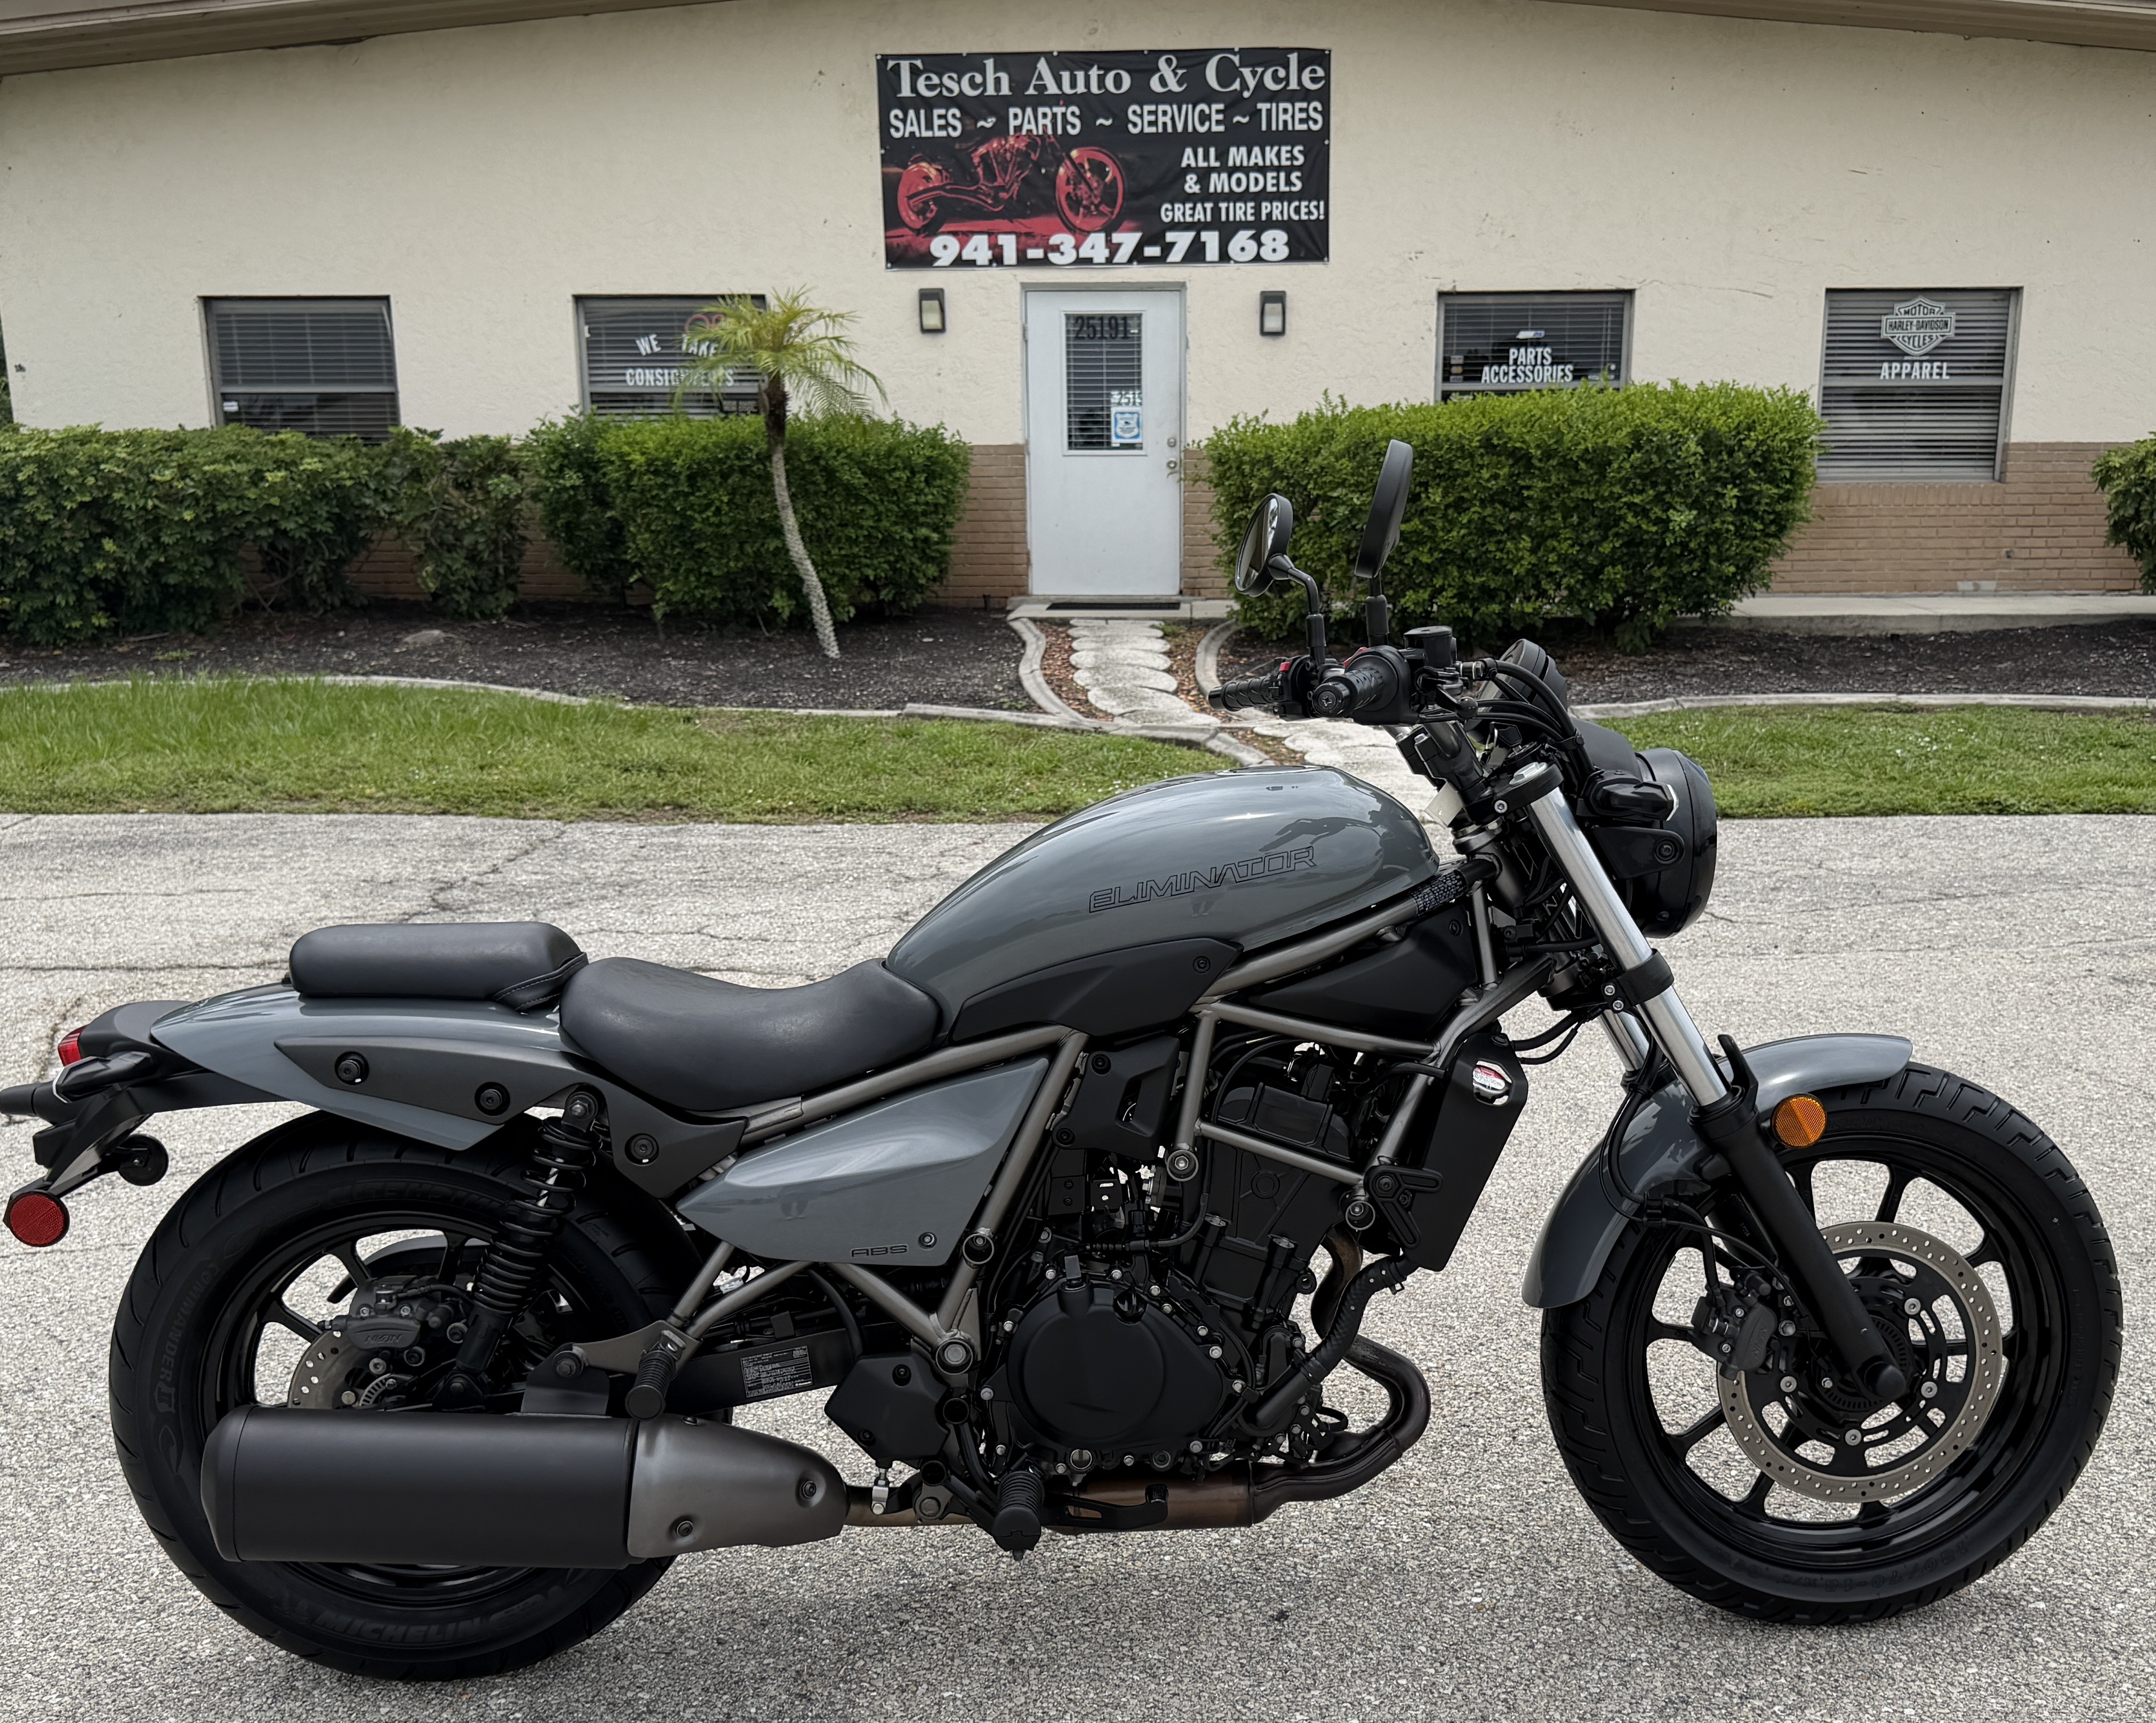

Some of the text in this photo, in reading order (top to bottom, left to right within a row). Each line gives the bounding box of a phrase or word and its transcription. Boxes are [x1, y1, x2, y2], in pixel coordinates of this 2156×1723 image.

[886, 52, 1326, 98] Tesch Auto & Cycle
[889, 108, 962, 139] SALES
[1008, 105, 1082, 136] PARTS
[1127, 103, 1226, 134] SERVICE
[1256, 101, 1324, 132] TIRES
[1180, 144, 1305, 168] ALL MAKES
[1183, 170, 1303, 194] & MODELS
[1160, 200, 1326, 223] GREAT TIRE PRICES!
[930, 230, 1290, 266] 941-347-7168
[1903, 304, 1936, 316] MOTOR
[1073, 316, 1130, 340] 25191
[635, 333, 662, 356] WE
[1901, 334, 1934, 348] CYCLES
[1509, 347, 1552, 366] PARTS
[1481, 364, 1574, 384] ACCESSORIES
[1880, 361, 1950, 380] APPAREL
[1089, 845, 1318, 913] ELIMINATOR
[851, 1245, 908, 1257] ABS
[159, 1263, 220, 1383] COMMANDER
[315, 1608, 483, 1643] MICHELIN
